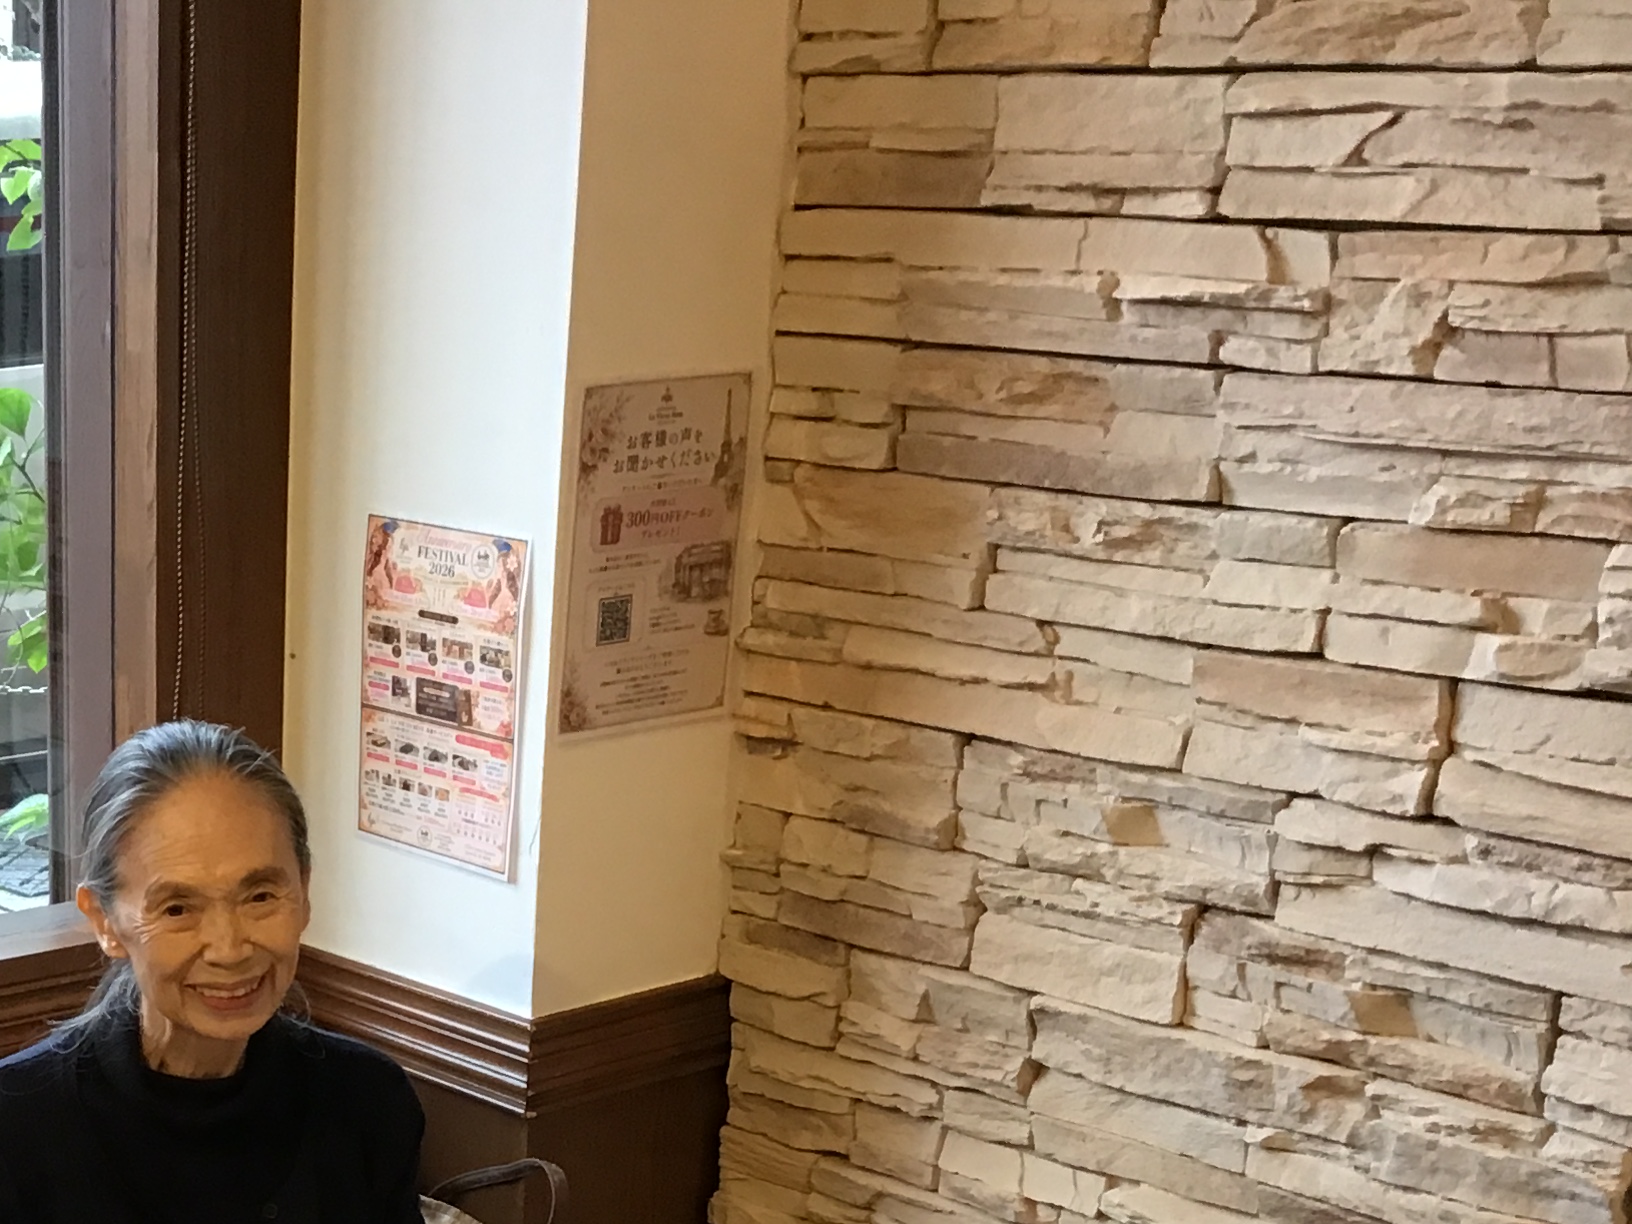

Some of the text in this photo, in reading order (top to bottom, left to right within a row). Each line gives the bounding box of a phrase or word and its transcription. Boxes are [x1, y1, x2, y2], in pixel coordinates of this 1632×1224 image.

[626, 427, 703, 449] お客様の声を
[613, 449, 716, 473] お聞かせください
[418, 545, 468, 566] FESTIVAL
[428, 562, 456, 579] 2026
